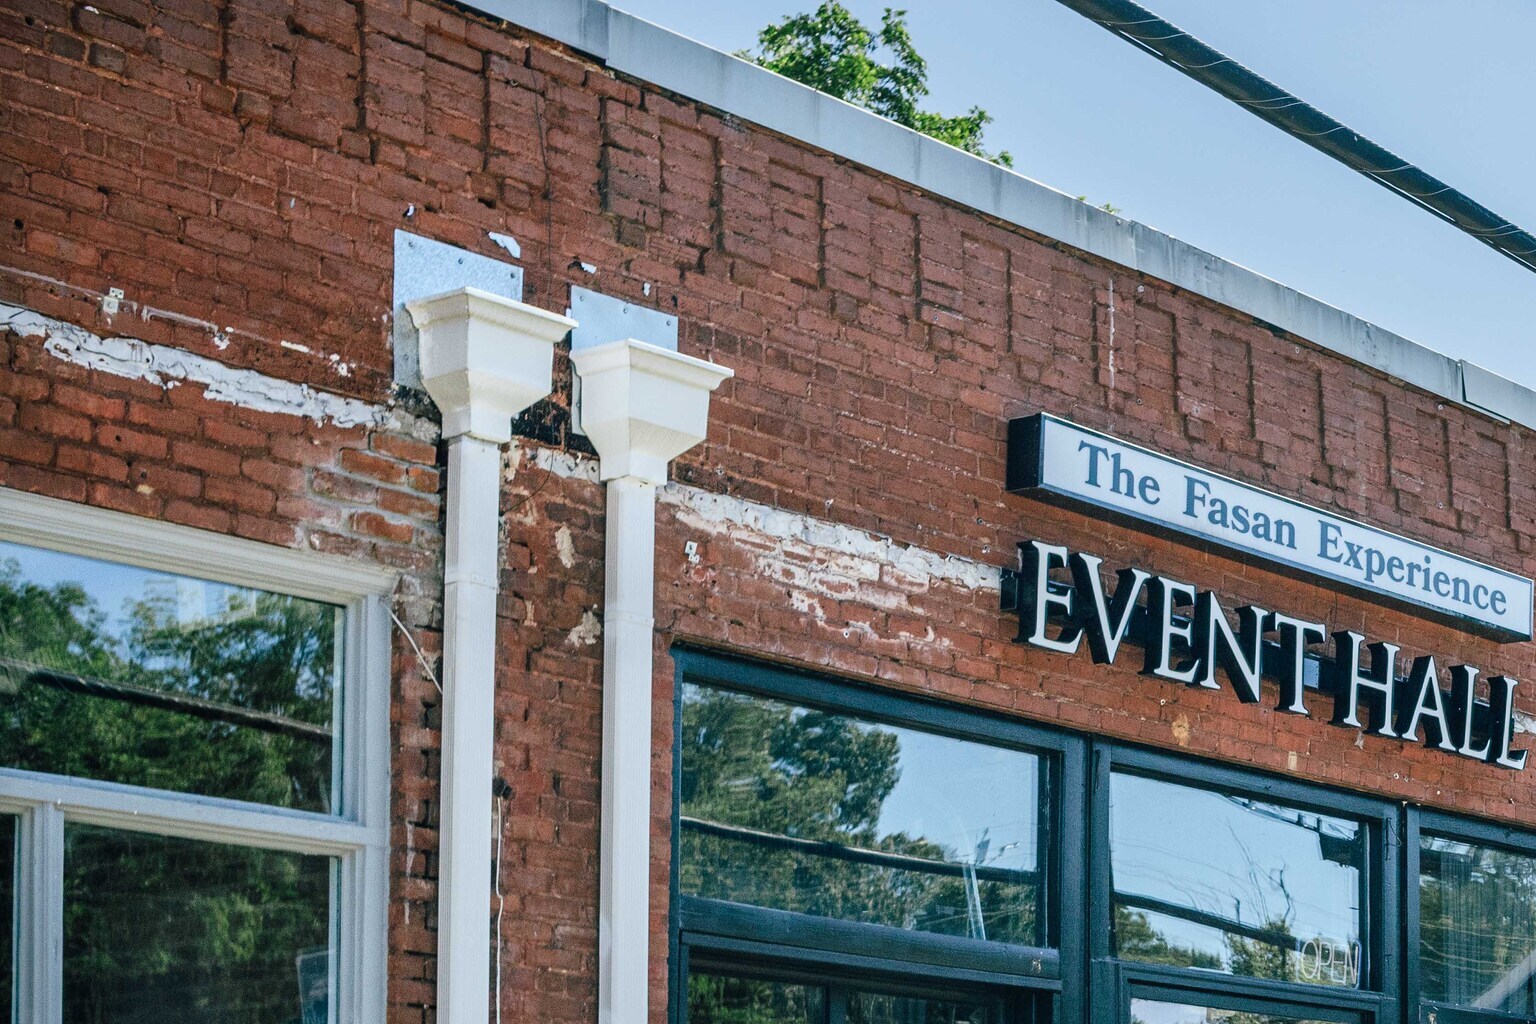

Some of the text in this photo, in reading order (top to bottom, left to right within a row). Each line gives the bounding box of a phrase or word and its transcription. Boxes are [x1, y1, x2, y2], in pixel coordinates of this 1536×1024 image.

[1078, 440, 1508, 616] The Fasan Experience
[1027, 539, 1529, 771] EVENT HALL
[1301, 940, 1359, 985] OPEN
